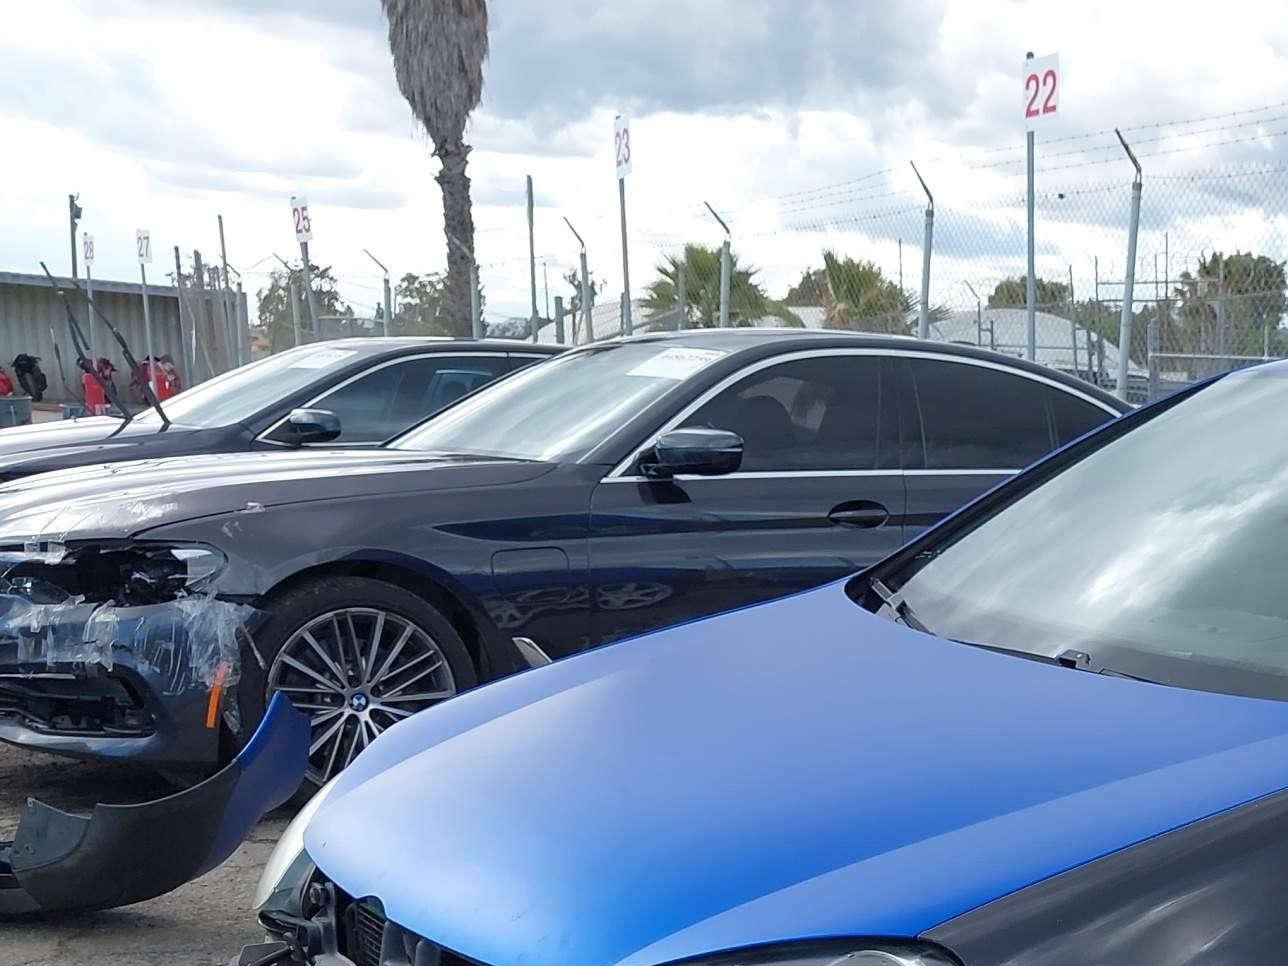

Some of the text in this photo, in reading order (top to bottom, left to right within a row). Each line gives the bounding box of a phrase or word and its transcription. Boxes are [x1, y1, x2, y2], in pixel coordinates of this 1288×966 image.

[1025, 69, 1057, 118] 22
[615, 127, 631, 168] 23
[292, 205, 311, 234] 25
[83, 240, 95, 260] 28
[137, 236, 150, 258] 27
